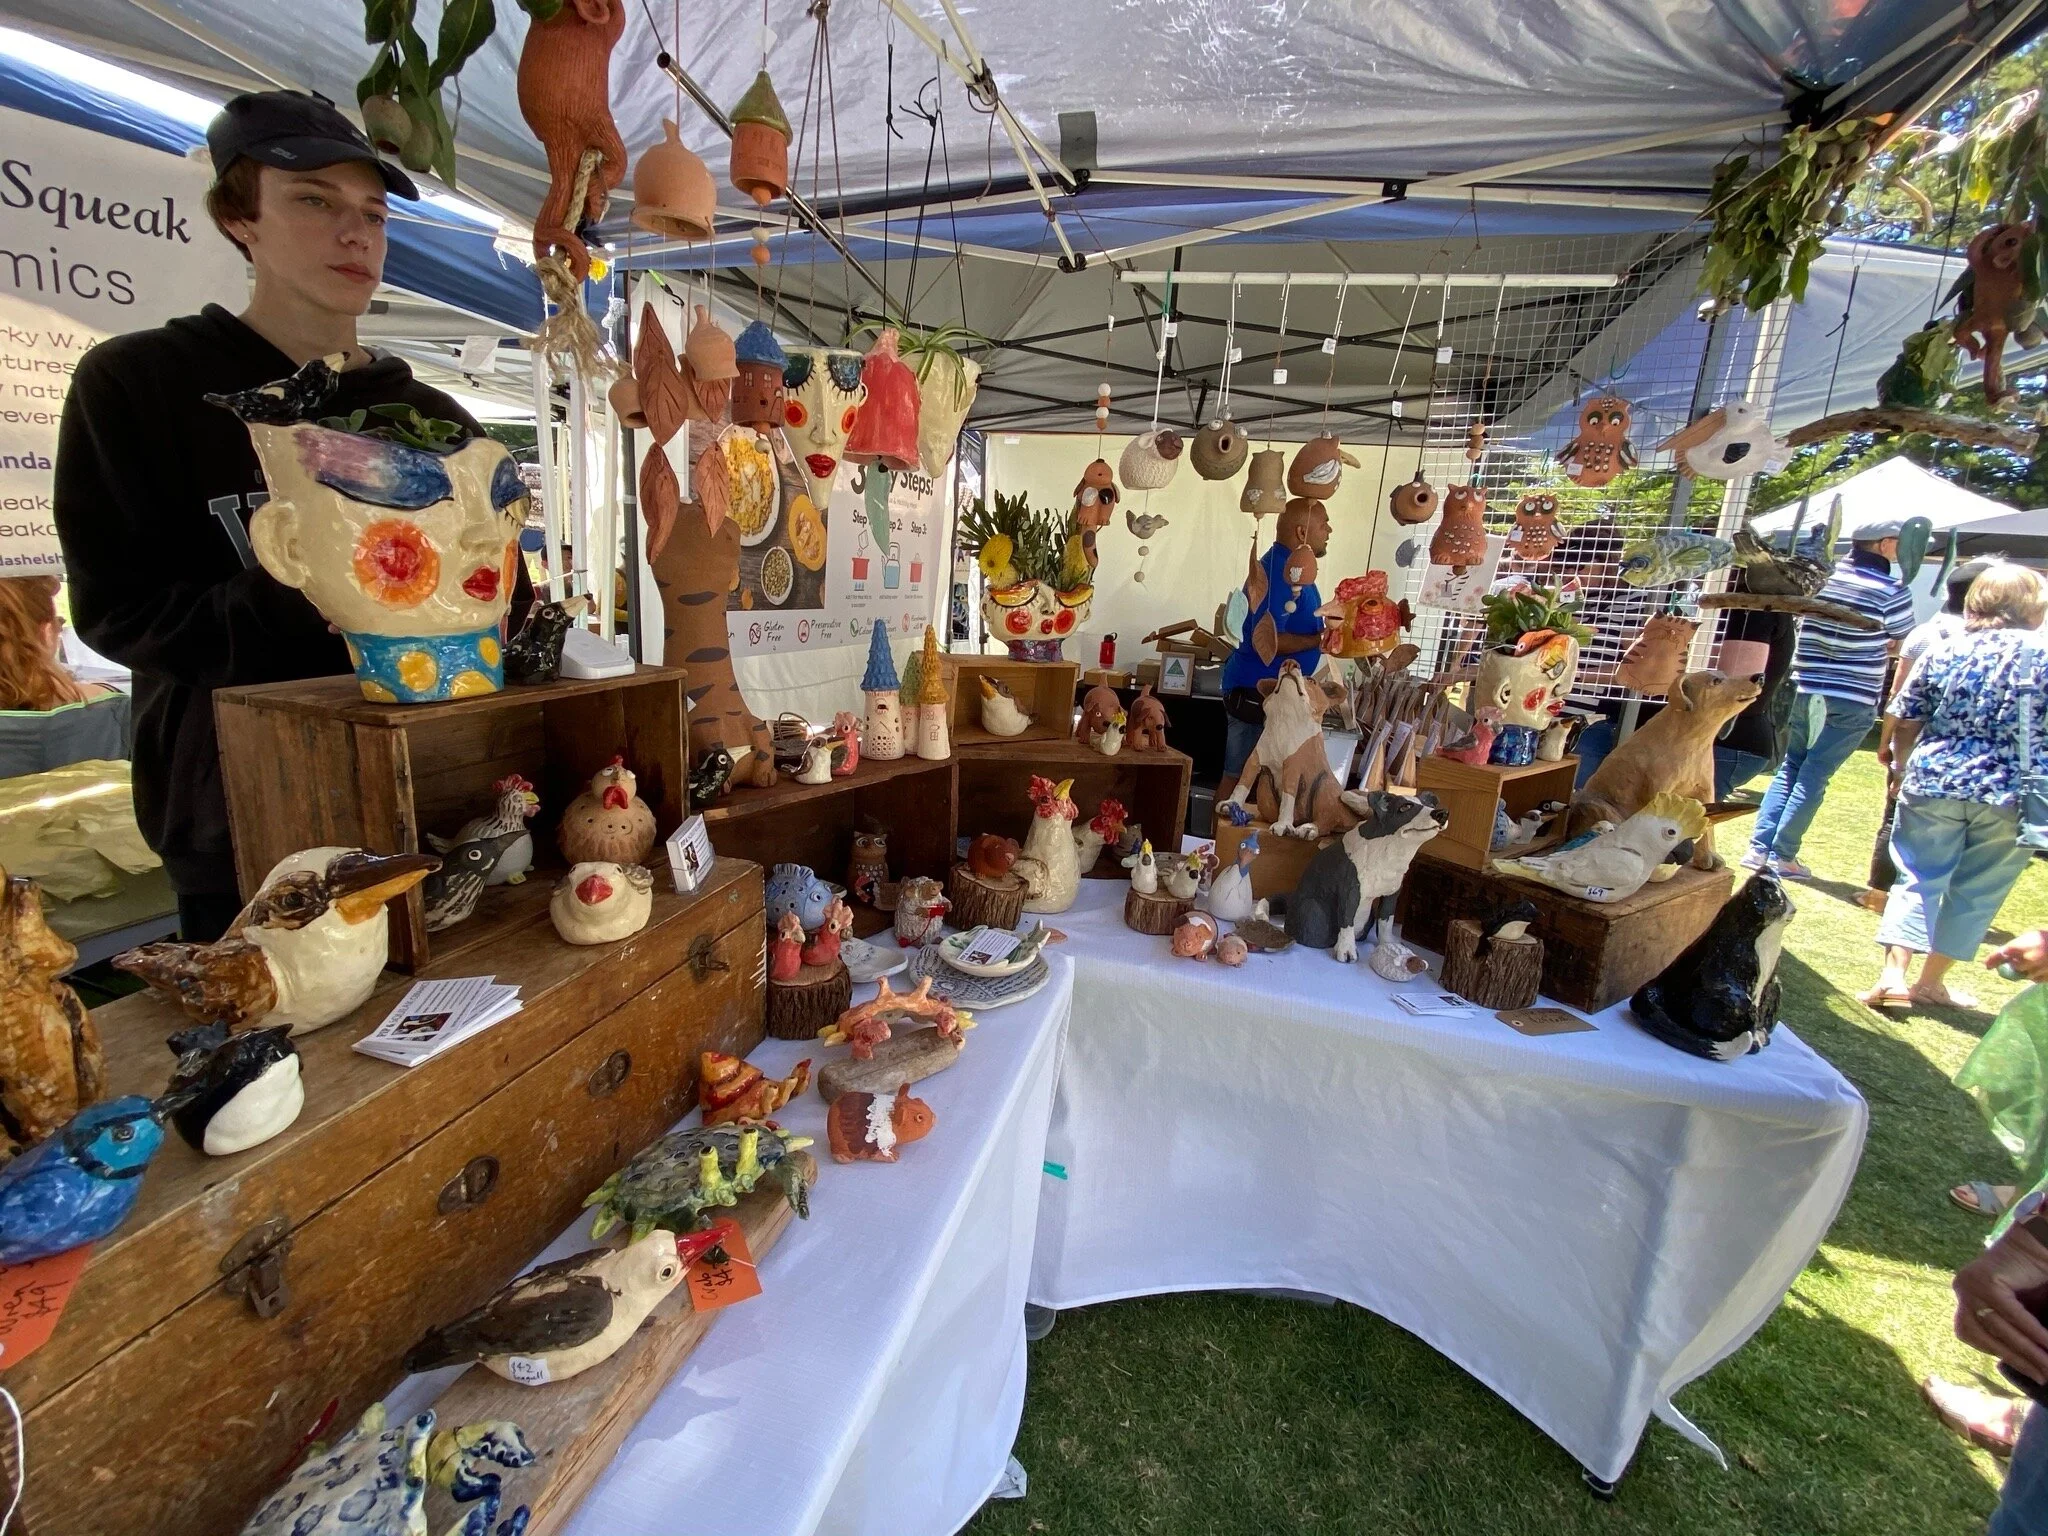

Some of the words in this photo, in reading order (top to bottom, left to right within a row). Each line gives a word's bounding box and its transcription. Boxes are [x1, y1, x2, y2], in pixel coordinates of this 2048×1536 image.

[0, 159, 191, 244] Squeak
[0, 354, 77, 375] tures
[0, 451, 52, 470] nda
[0, 496, 52, 511] eak
[852, 509, 868, 528] Step
[911, 521, 922, 537] Step
[764, 621, 785, 632] Gluten
[821, 629, 832, 639] Free
[767, 632, 782, 642] Free
[1587, 888, 1604, 897] $69
